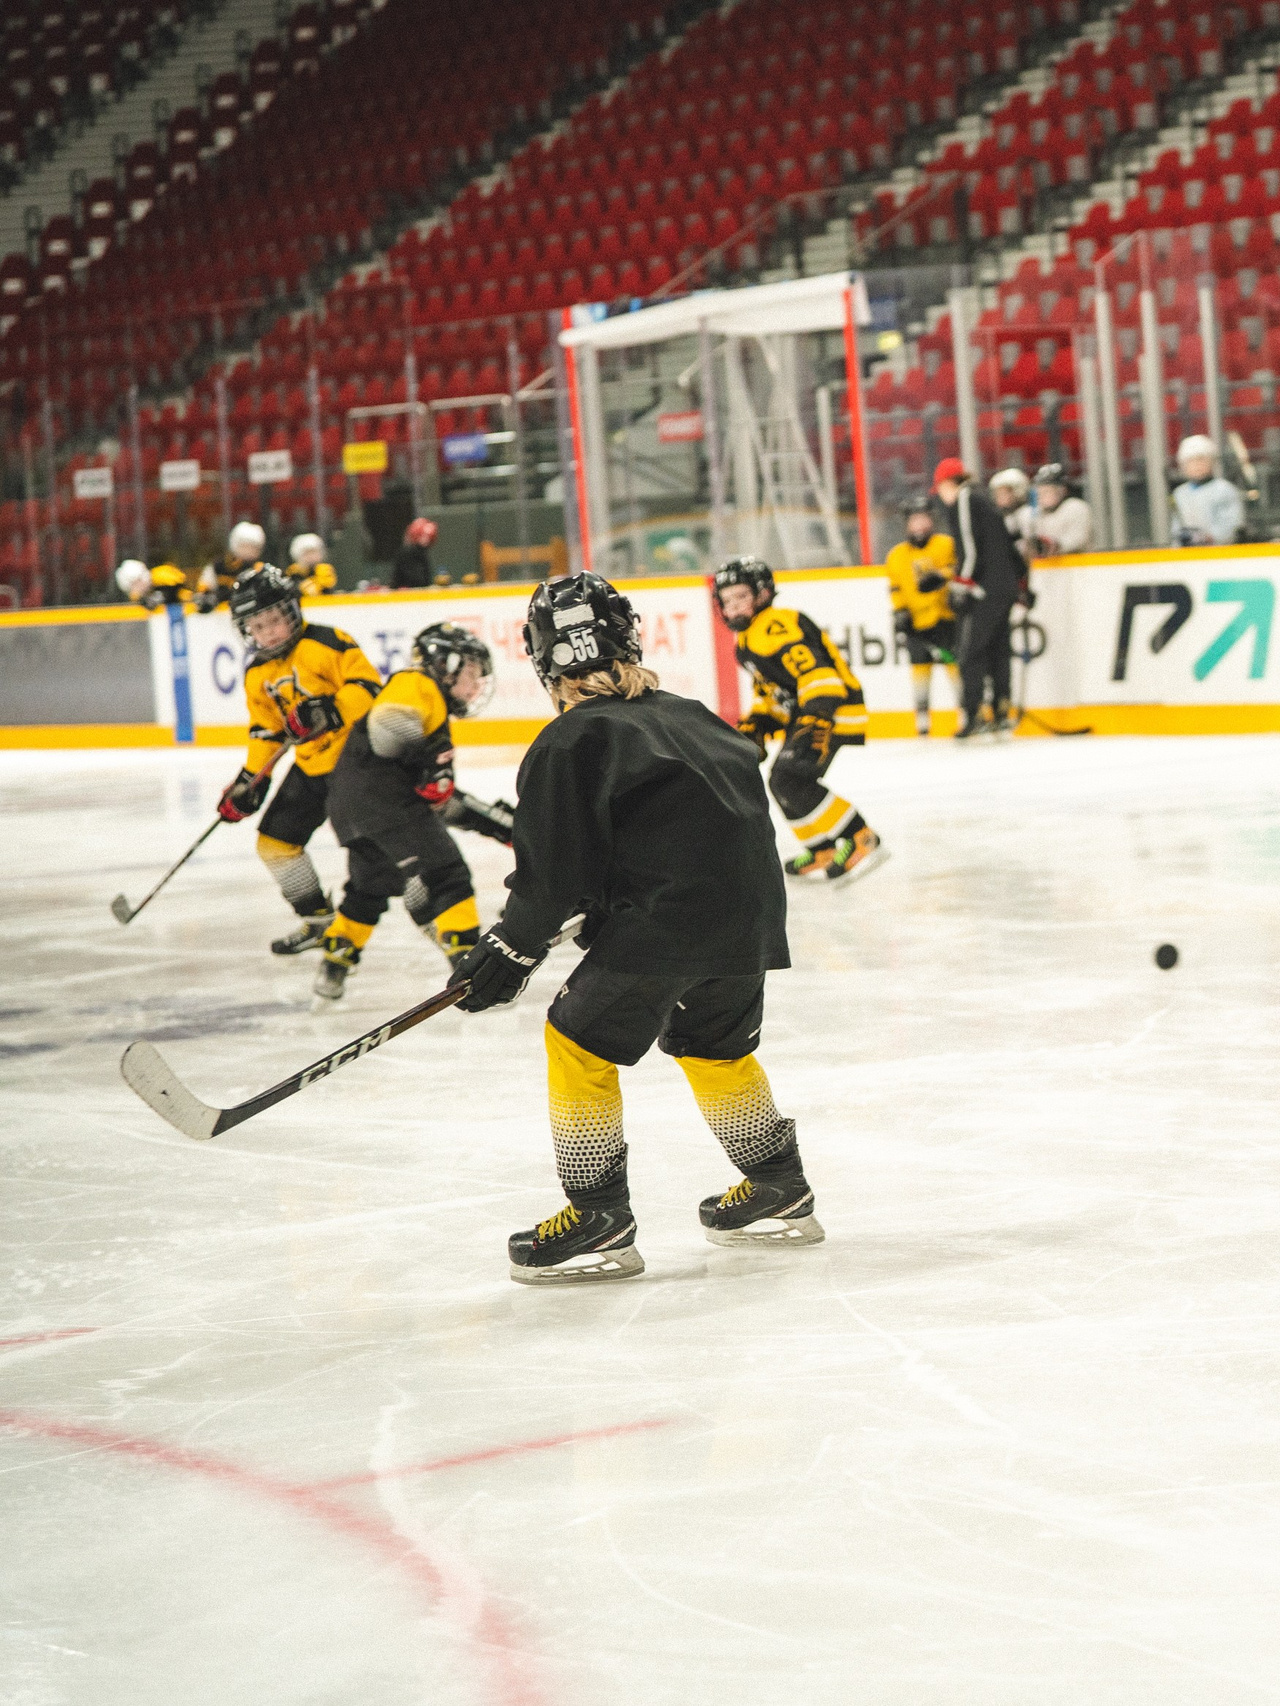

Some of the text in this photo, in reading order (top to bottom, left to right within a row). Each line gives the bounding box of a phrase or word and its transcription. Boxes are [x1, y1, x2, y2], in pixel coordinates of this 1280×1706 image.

[569, 628, 599, 661] 55
[487, 933, 537, 966] TRUE
[299, 1025, 391, 1090] CCM
